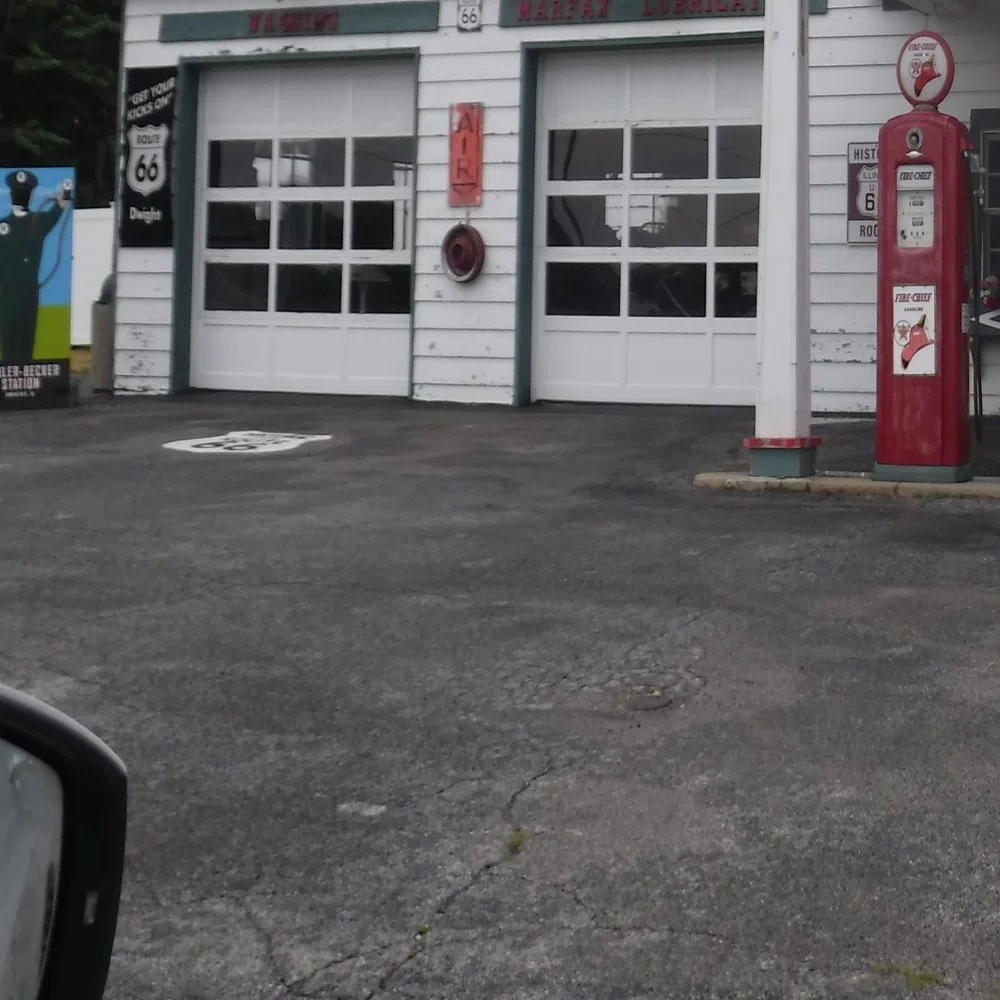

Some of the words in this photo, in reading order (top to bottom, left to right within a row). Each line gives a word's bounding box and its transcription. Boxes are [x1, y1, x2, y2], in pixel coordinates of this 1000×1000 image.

[461, 7, 477, 24] 66
[150, 76, 176, 99] YOUR
[126, 102, 153, 121] KICKS
[136, 133, 160, 144] ROUTE
[456, 111, 474, 179] AIR
[853, 148, 879, 160] HIST
[135, 153, 159, 183] 66
[865, 193, 875, 212] 6
[129, 206, 162, 224] Dwight
[895, 292, 932, 303] FIRE-CHIEF
[1, 377, 40, 390] STATION
